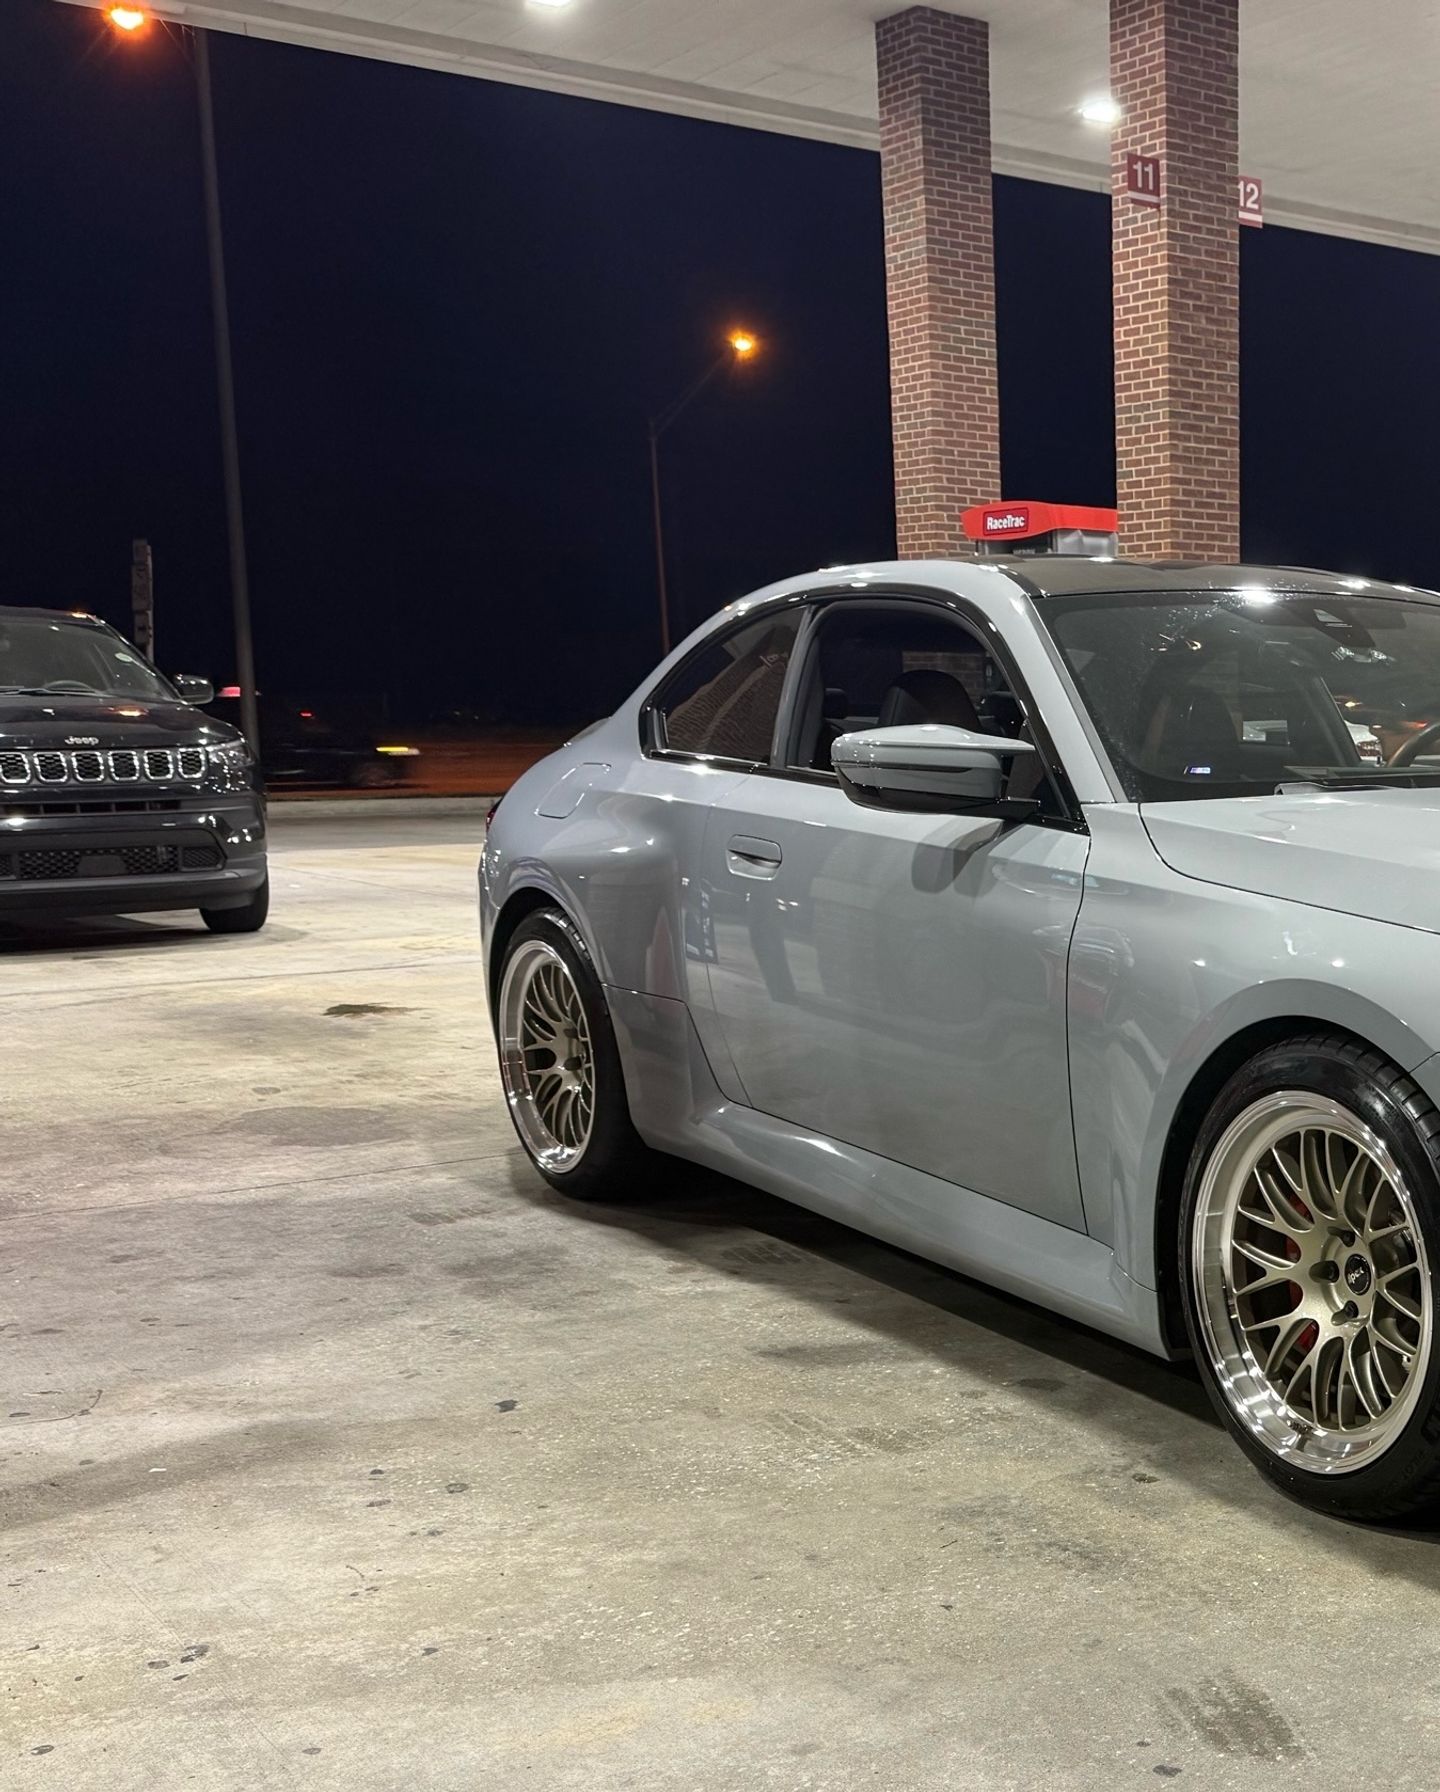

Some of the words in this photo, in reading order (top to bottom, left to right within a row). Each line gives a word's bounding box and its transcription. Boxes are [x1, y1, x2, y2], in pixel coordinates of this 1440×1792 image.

[1133, 161, 1154, 190] 11
[1238, 180, 1260, 210] 12
[986, 515, 1025, 530] RaceTrac
[64, 735, 99, 746] Jeep
